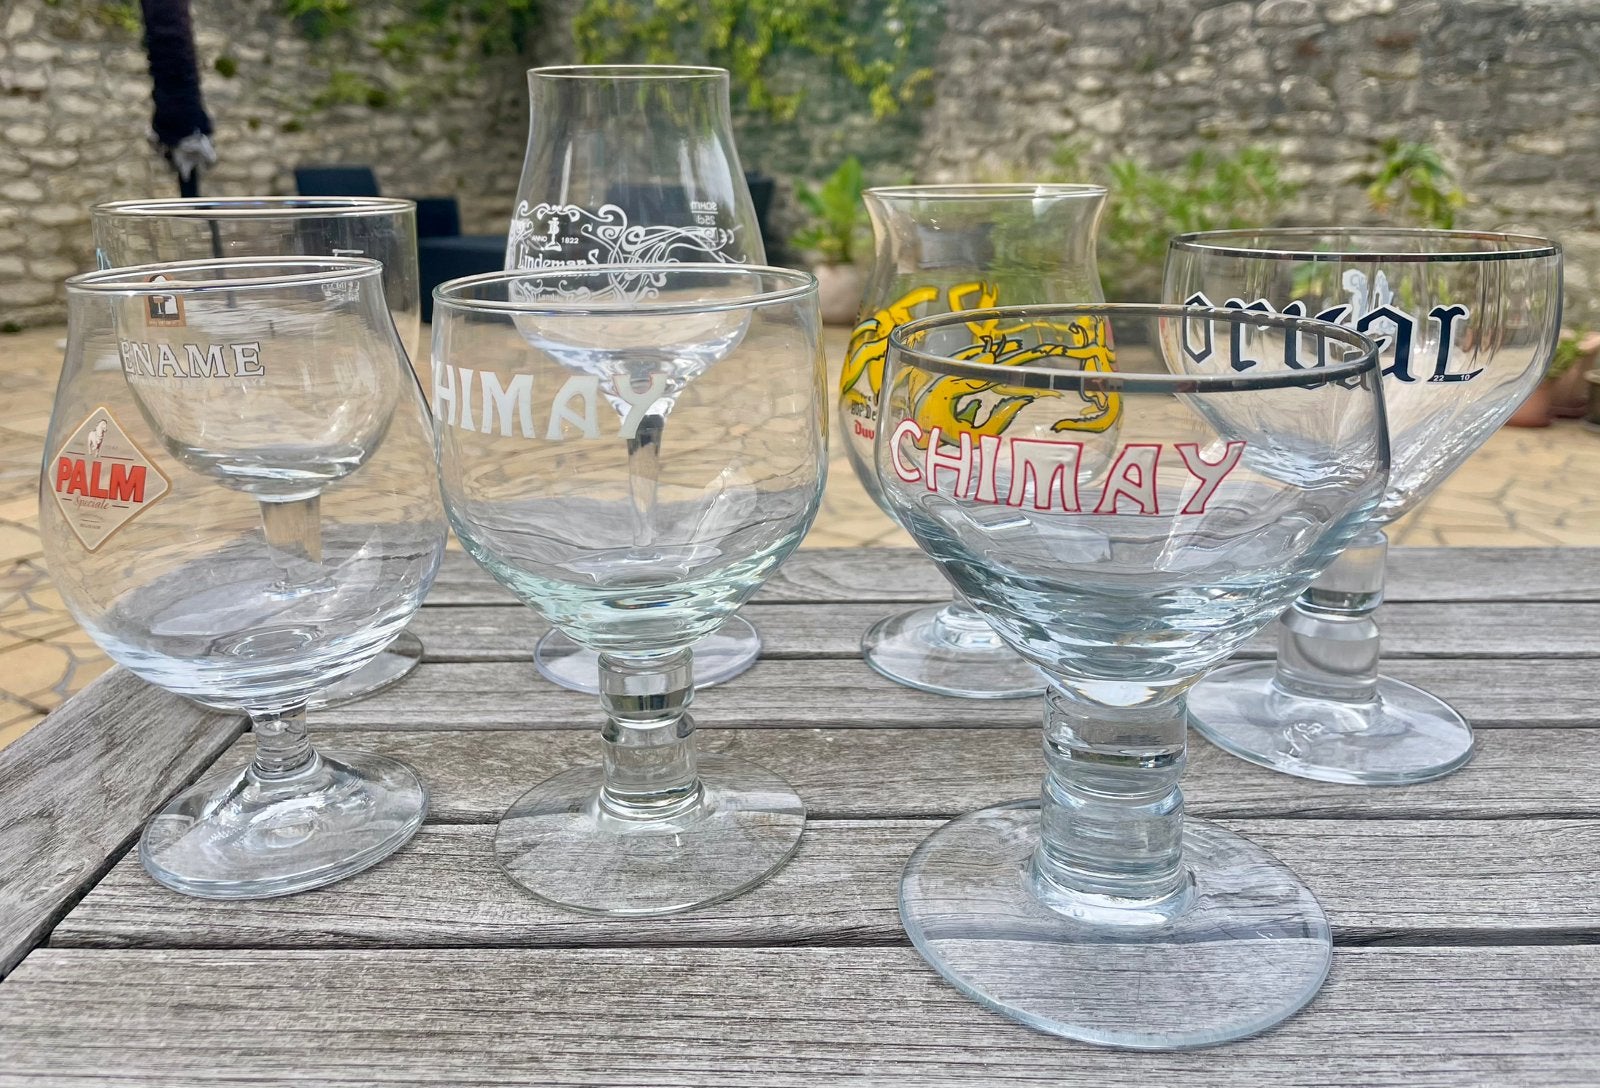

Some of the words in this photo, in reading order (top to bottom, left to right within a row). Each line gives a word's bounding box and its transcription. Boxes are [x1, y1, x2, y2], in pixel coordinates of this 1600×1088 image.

[560, 236, 580, 244] 1822
[119, 338, 266, 378] ENAME
[1432, 374, 1445, 382] 22
[56, 456, 147, 503] PALM
[888, 417, 1248, 515] CHIMAY
